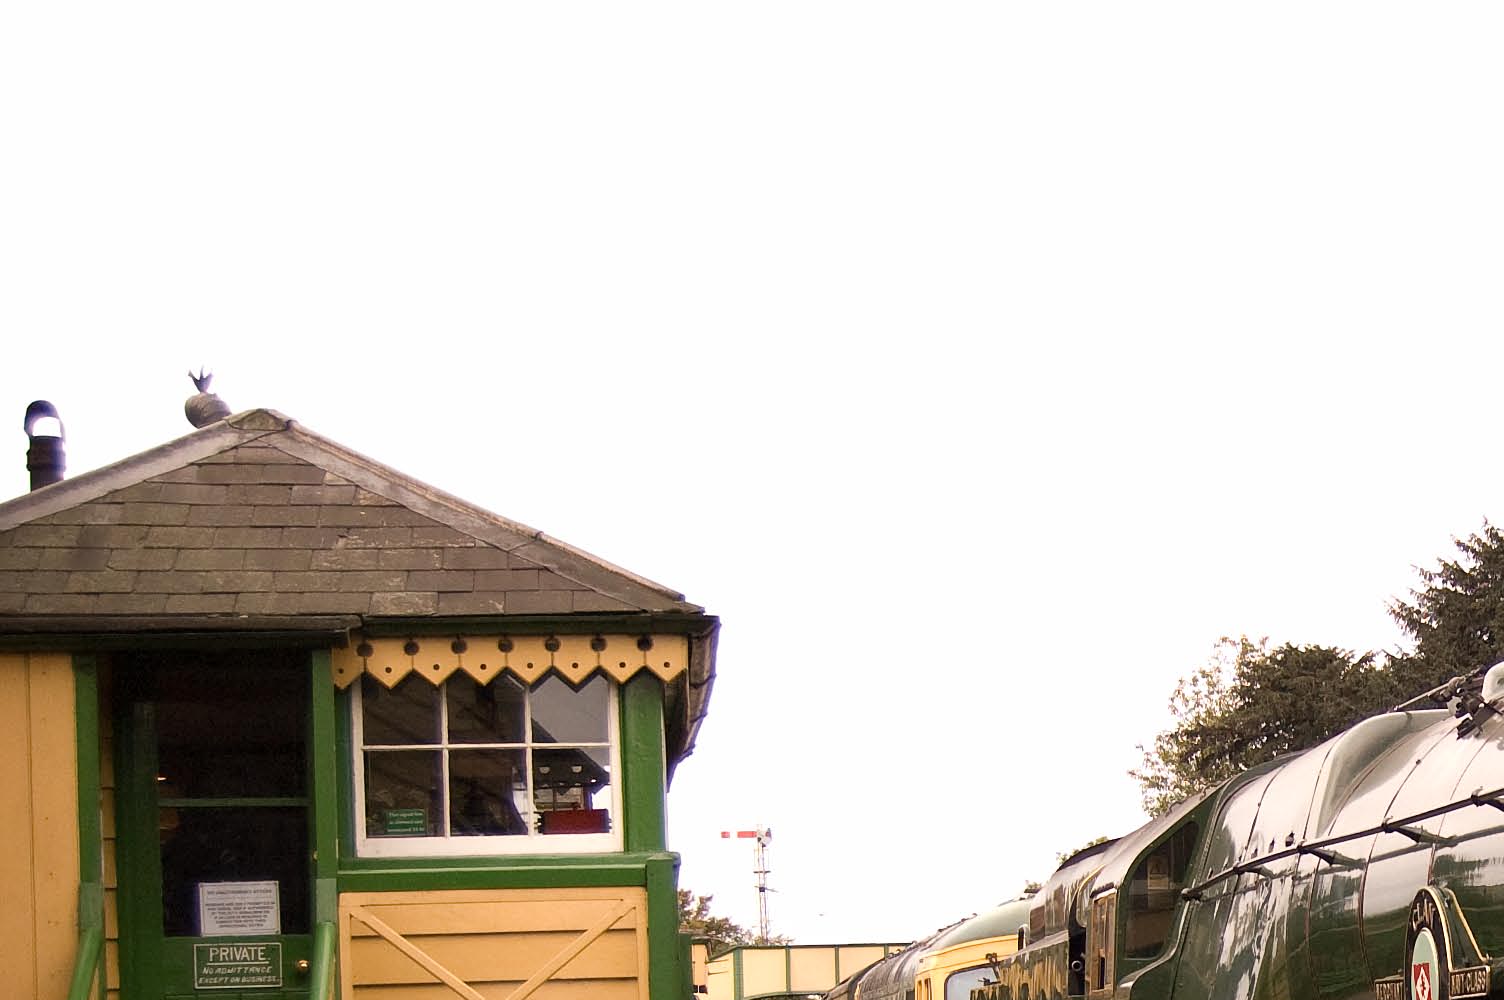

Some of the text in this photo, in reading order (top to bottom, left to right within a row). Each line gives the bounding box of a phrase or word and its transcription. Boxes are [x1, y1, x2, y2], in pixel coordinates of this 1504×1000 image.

[202, 965, 272, 975] NO ADMITTANCE
[198, 976, 229, 984] EXCEPT
